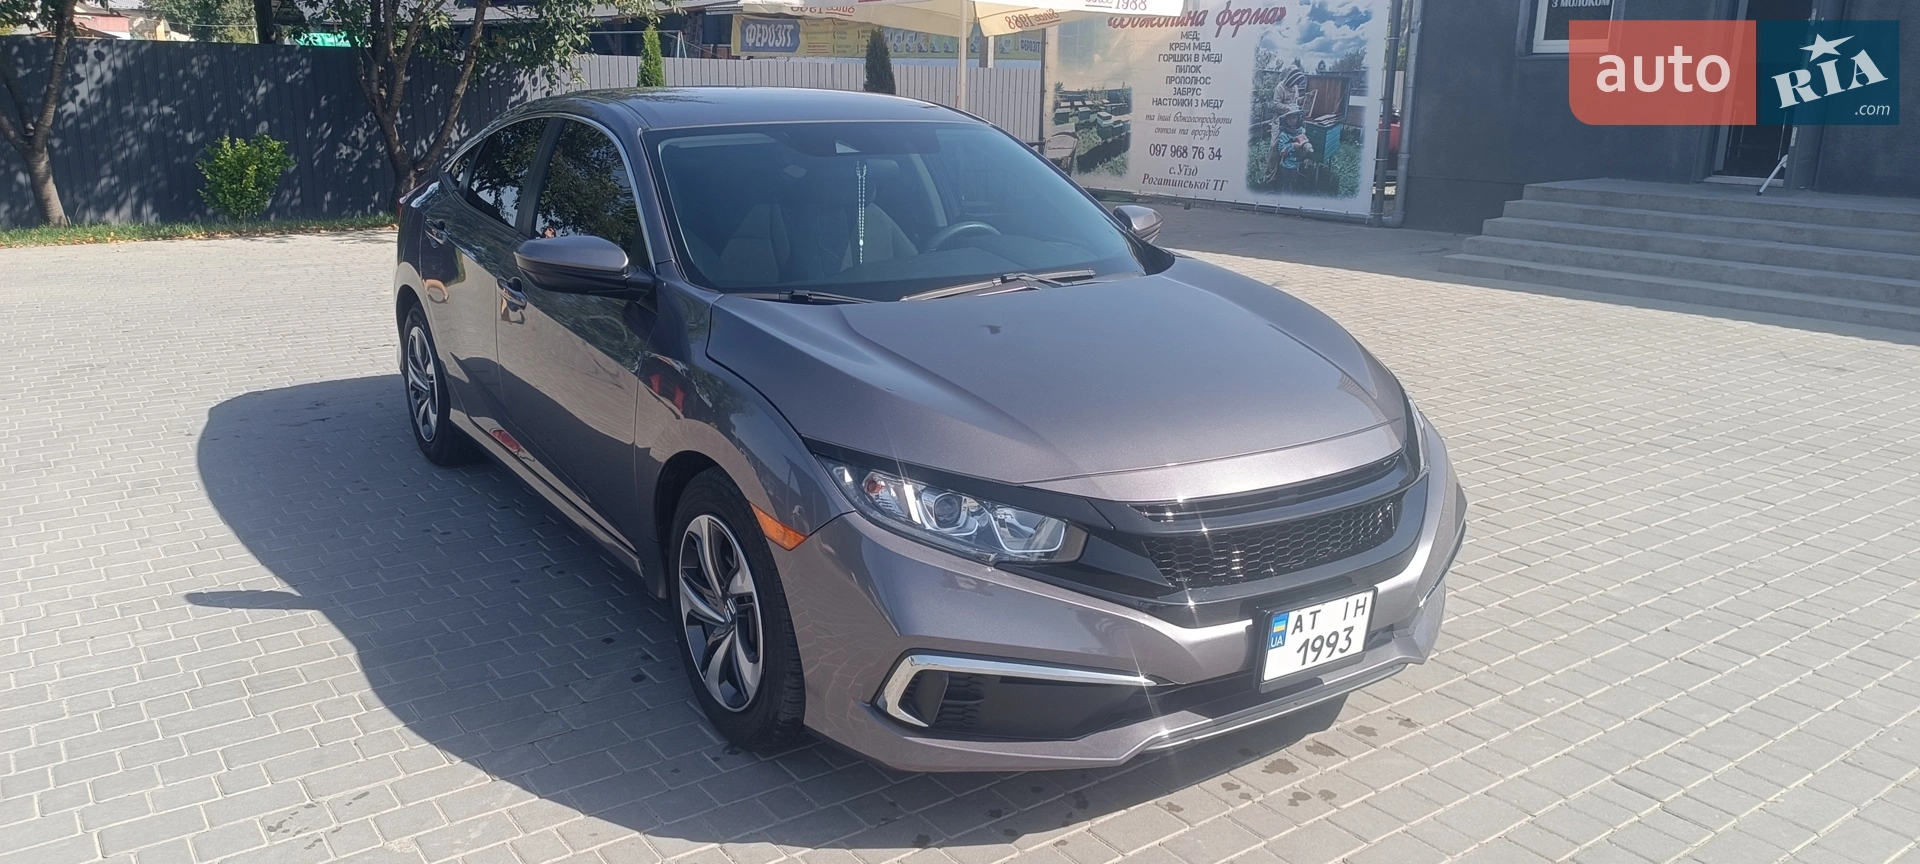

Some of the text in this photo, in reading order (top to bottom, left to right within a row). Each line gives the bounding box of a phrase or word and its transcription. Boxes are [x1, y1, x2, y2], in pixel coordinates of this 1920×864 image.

[1215, 0, 1287, 38] ферма»
[745, 24, 794, 47] ФЕРОЗІТ
[1169, 42, 1211, 52] КРЕМ МЕД
[1158, 53, 1223, 64] ГОРІШКИ В МЕДІ
[1175, 65, 1202, 73] ПИЛОК
[1165, 76, 1212, 85] ПРОПОЛЮС
[1173, 87, 1202, 96] ЗАБРУС
[1200, 99, 1225, 109] МЕДУ
[1145, 113, 1156, 121] та
[1157, 113, 1172, 121] інші
[1154, 127, 1177, 135] оптом
[1149, 143, 1223, 161] 097 968 76 34
[1141, 173, 1229, 191] Рогатинської ТГ
[1291, 609, 1322, 636] AT
[1270, 636, 1284, 648] UA
[1296, 625, 1355, 666] 1993
